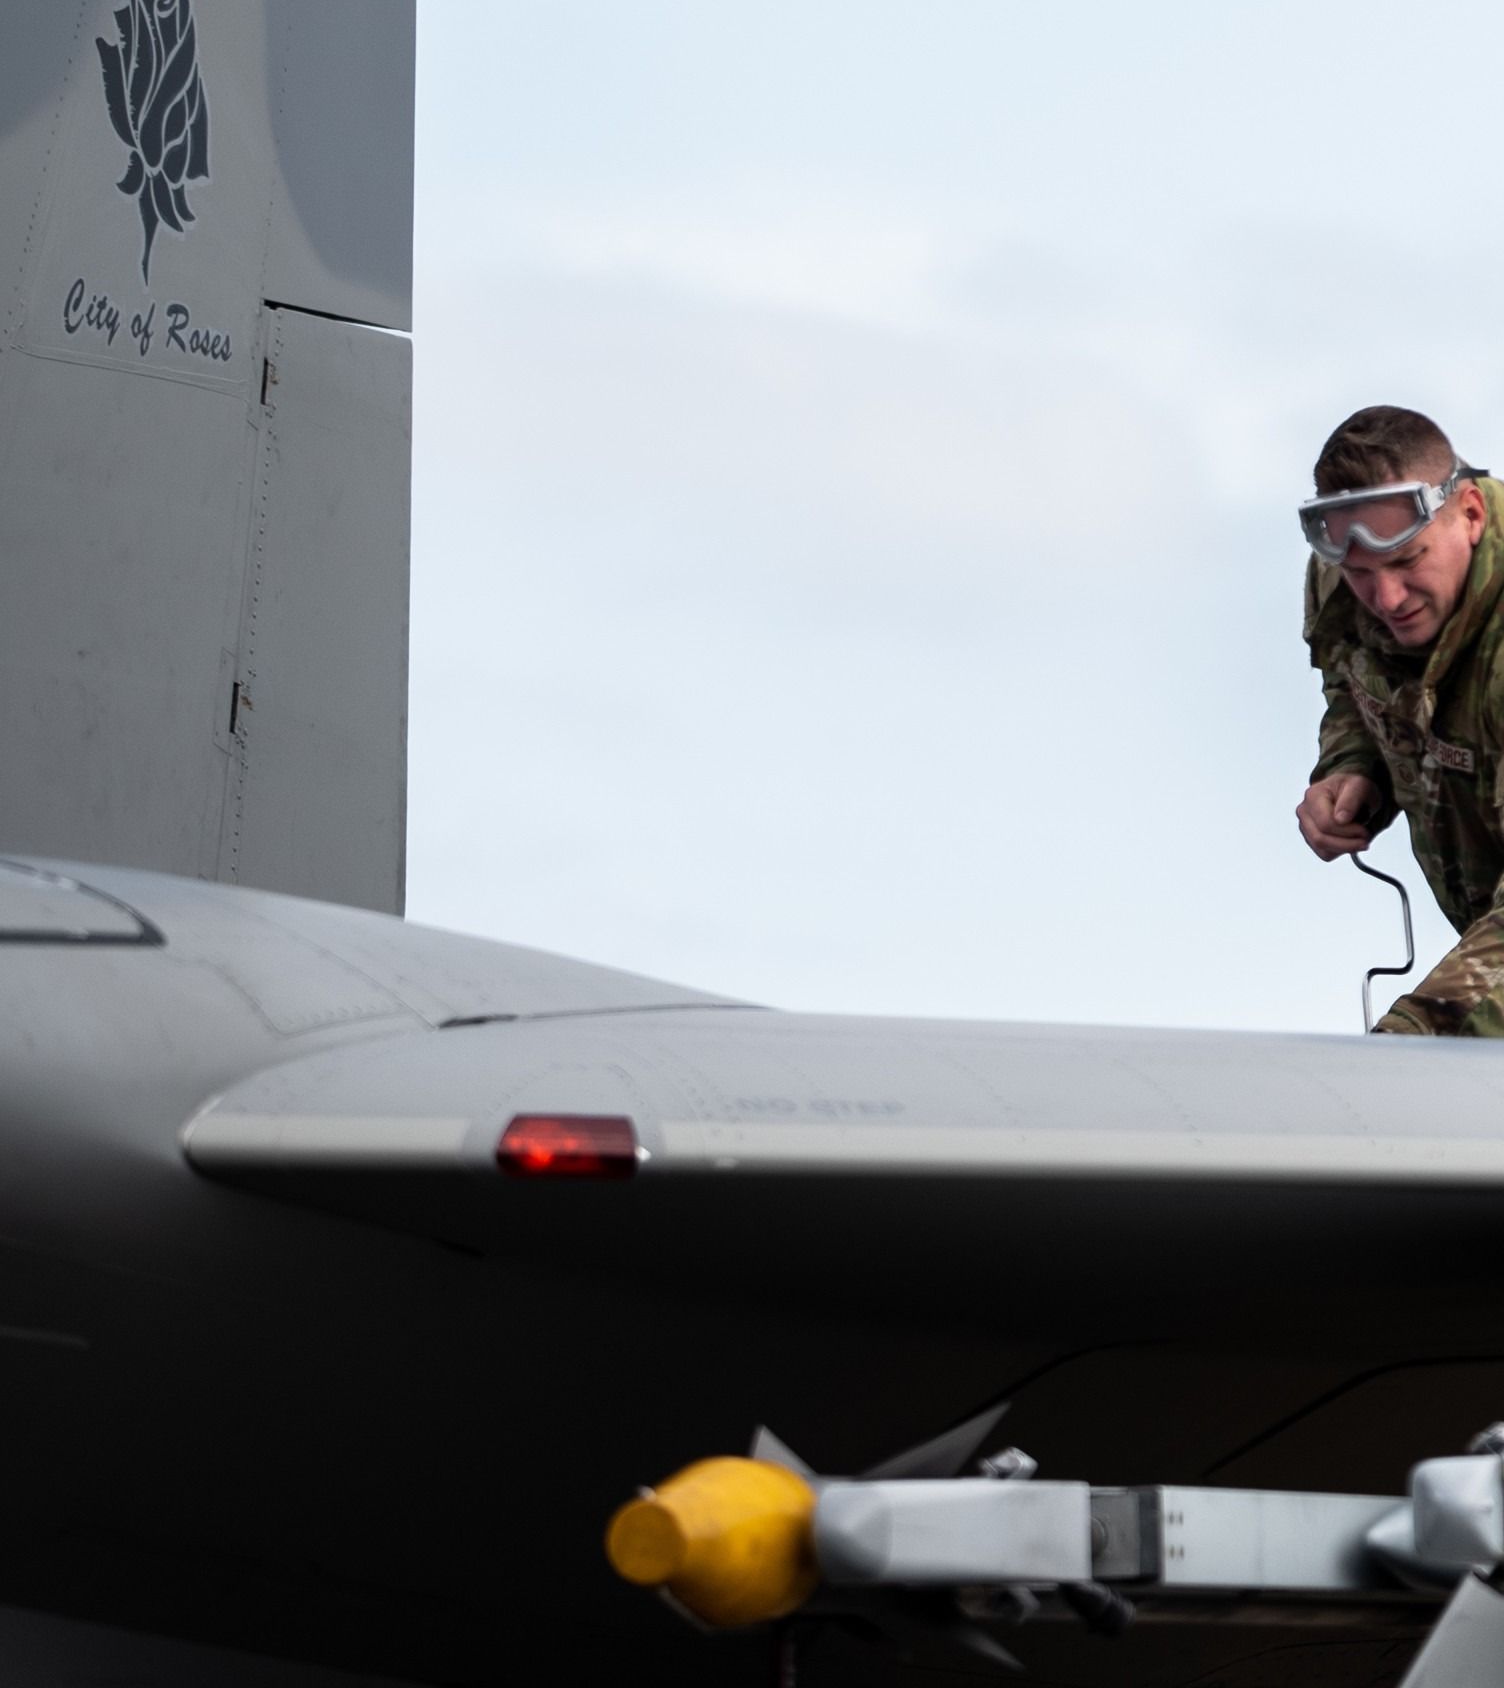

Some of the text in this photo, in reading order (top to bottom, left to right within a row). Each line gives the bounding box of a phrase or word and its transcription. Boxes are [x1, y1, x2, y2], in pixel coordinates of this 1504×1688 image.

[63, 277, 233, 362] City of Roses
